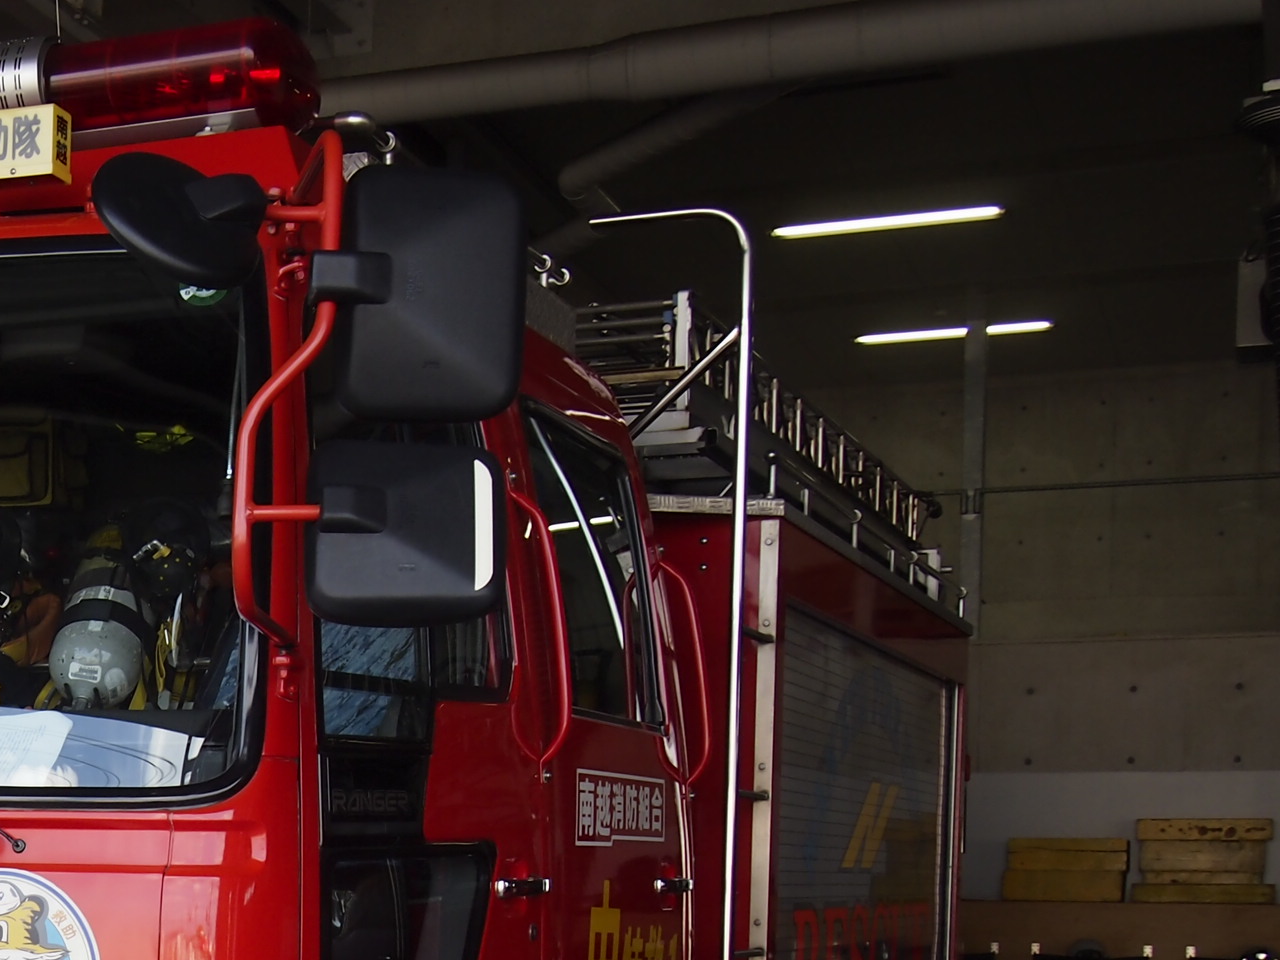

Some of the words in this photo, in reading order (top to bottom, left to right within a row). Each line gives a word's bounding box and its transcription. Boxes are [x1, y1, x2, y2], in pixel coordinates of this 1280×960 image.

[55, 114, 69, 166] 南越
[332, 788, 409, 814] RANGER
[578, 777, 664, 838] 南越消防組合
[51, 909, 77, 940] 救助
